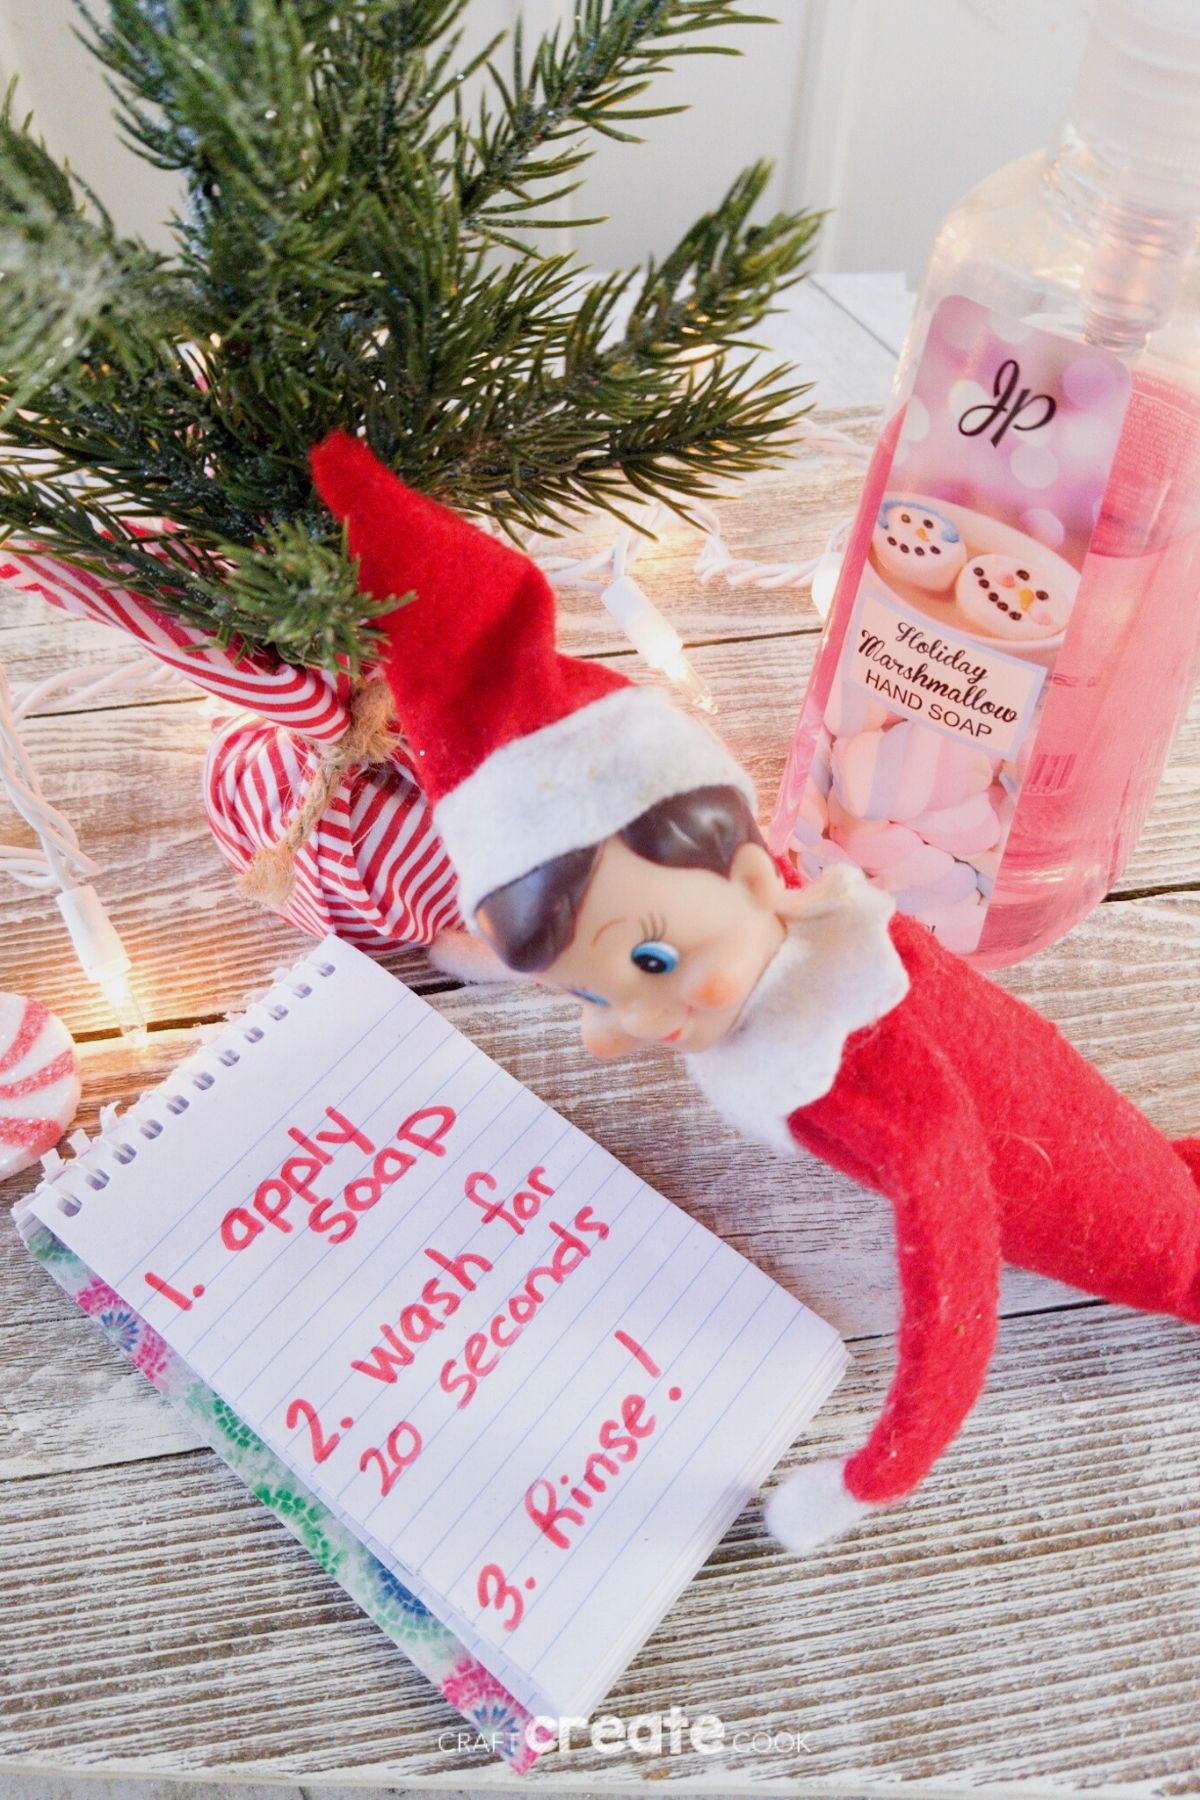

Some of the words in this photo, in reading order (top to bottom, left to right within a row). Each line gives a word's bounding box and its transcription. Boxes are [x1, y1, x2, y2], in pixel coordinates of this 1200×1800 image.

[858, 629, 1019, 724] Marshmallow
[865, 669, 923, 711] HAND
[928, 703, 993, 738] SOAP
[896, 621, 988, 685] Holiday
[144, 1271, 206, 1312] 1.
[220, 1105, 377, 1252] apply
[308, 1105, 457, 1245] soap
[286, 1398, 355, 1464] 2.
[464, 1166, 556, 1236] for
[359, 1420, 423, 1497] 20
[439, 1206, 610, 1411] seconds
[477, 1563, 537, 1632] 3.
[524, 1329, 683, 1550] Rinse!
